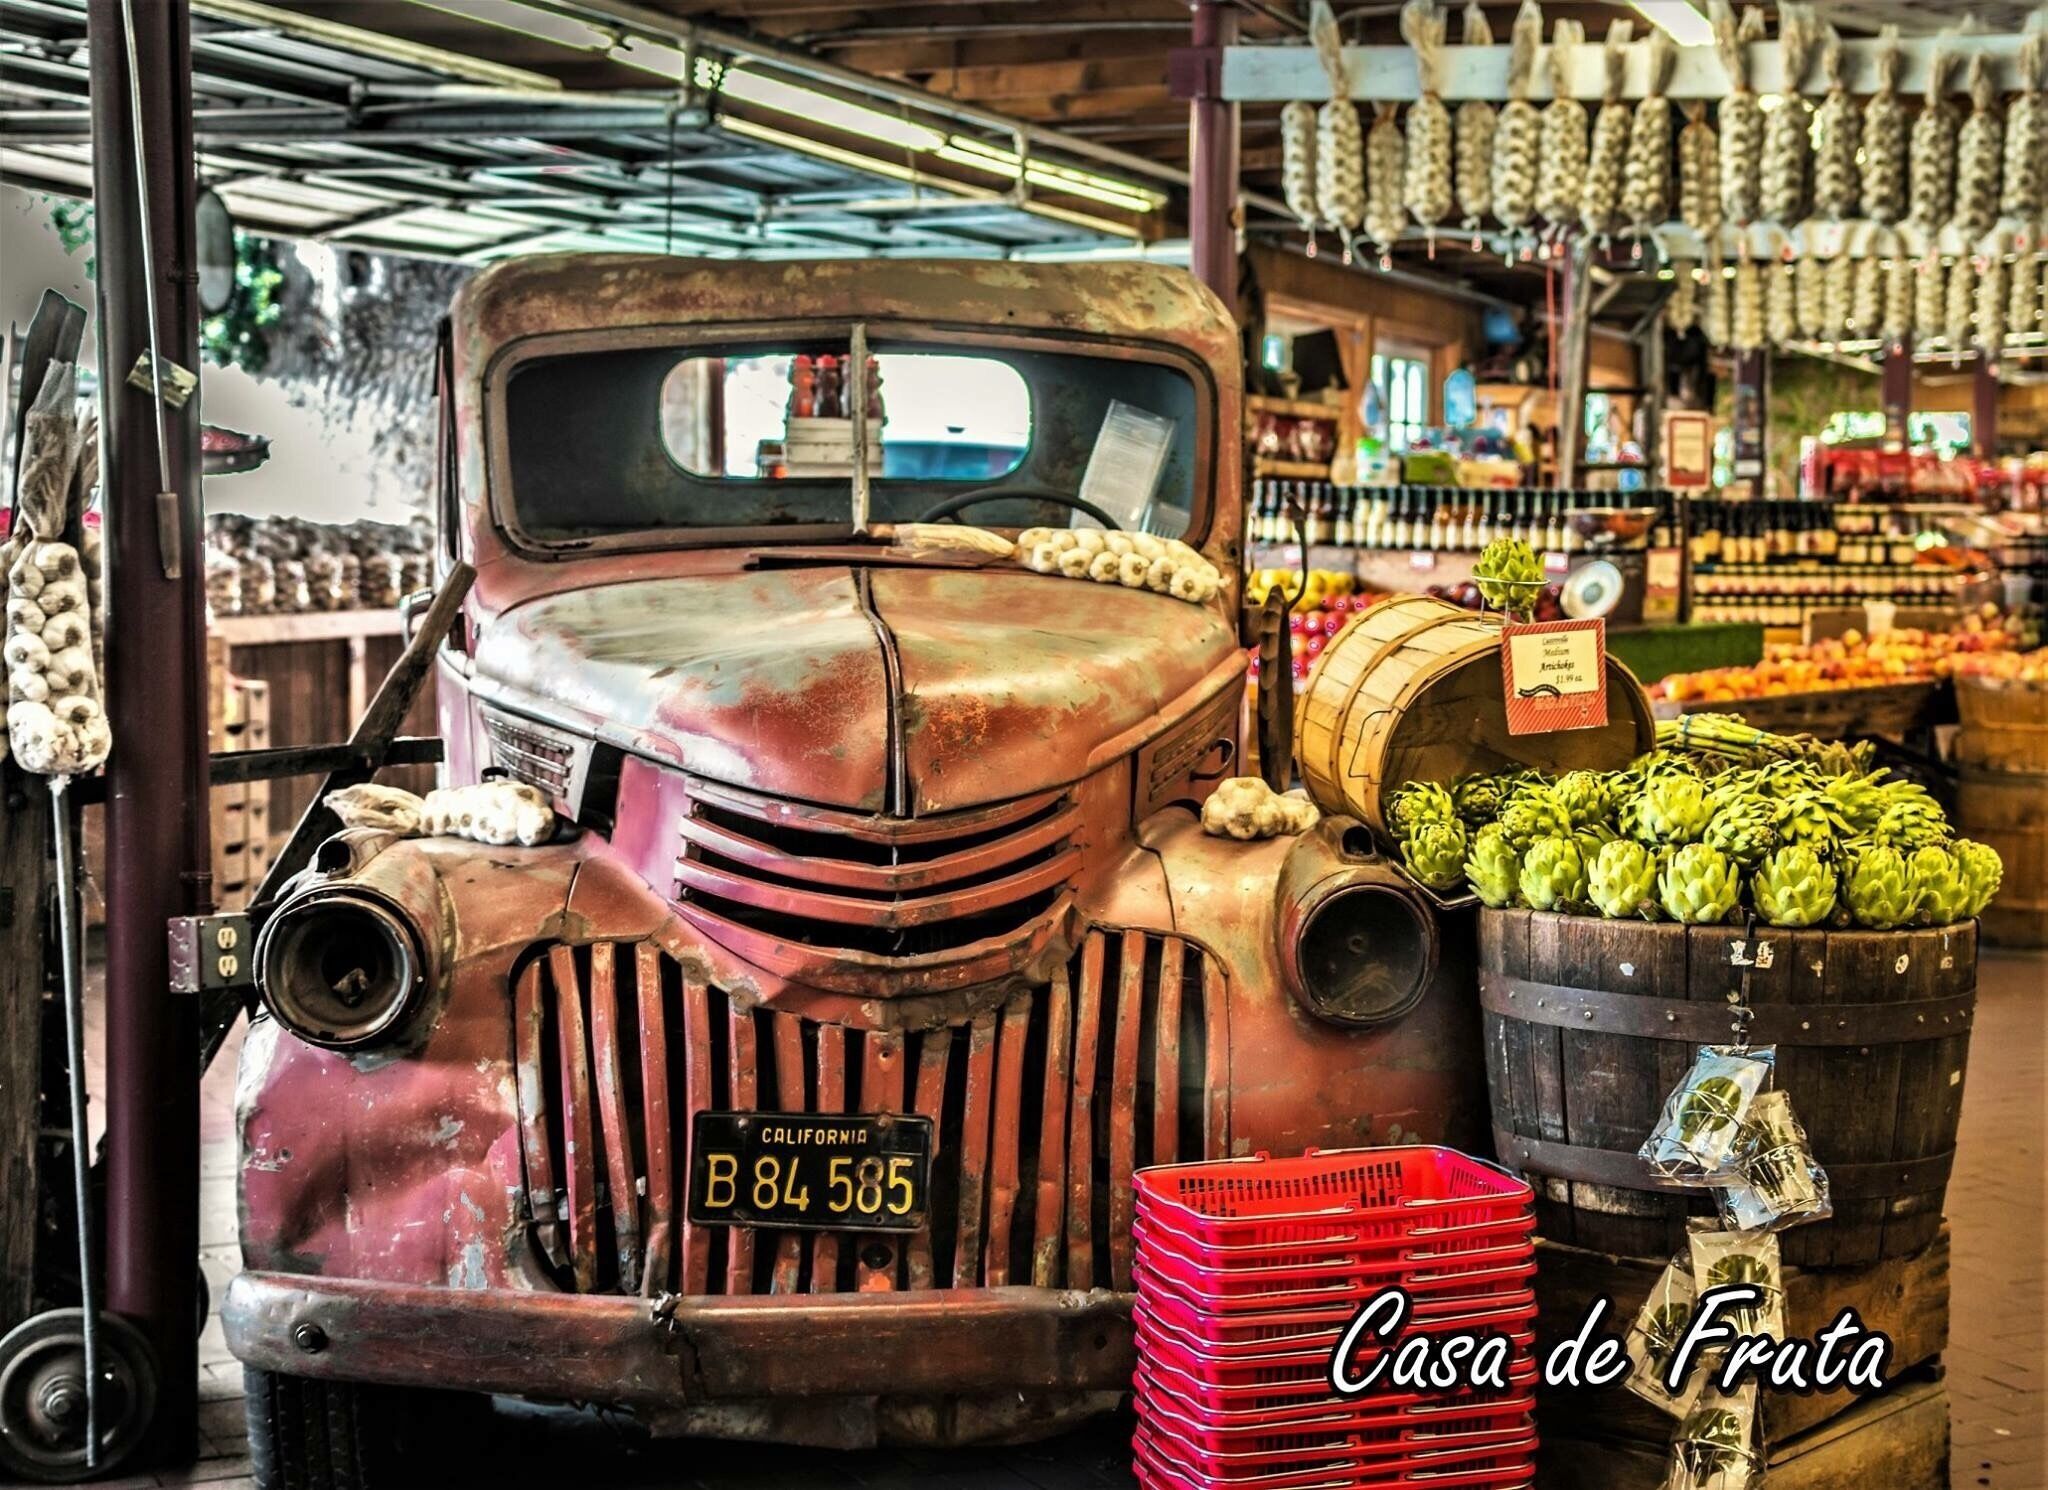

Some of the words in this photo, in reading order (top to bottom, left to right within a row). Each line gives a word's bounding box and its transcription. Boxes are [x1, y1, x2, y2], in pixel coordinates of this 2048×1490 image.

[1540, 660, 1574, 673] Artichokes
[1556, 674, 1574, 685] $1.99
[762, 1127, 867, 1145] CALIFORNIA
[704, 1154, 738, 1208] B
[753, 1155, 810, 1212] 84
[828, 1156, 914, 1215] 585
